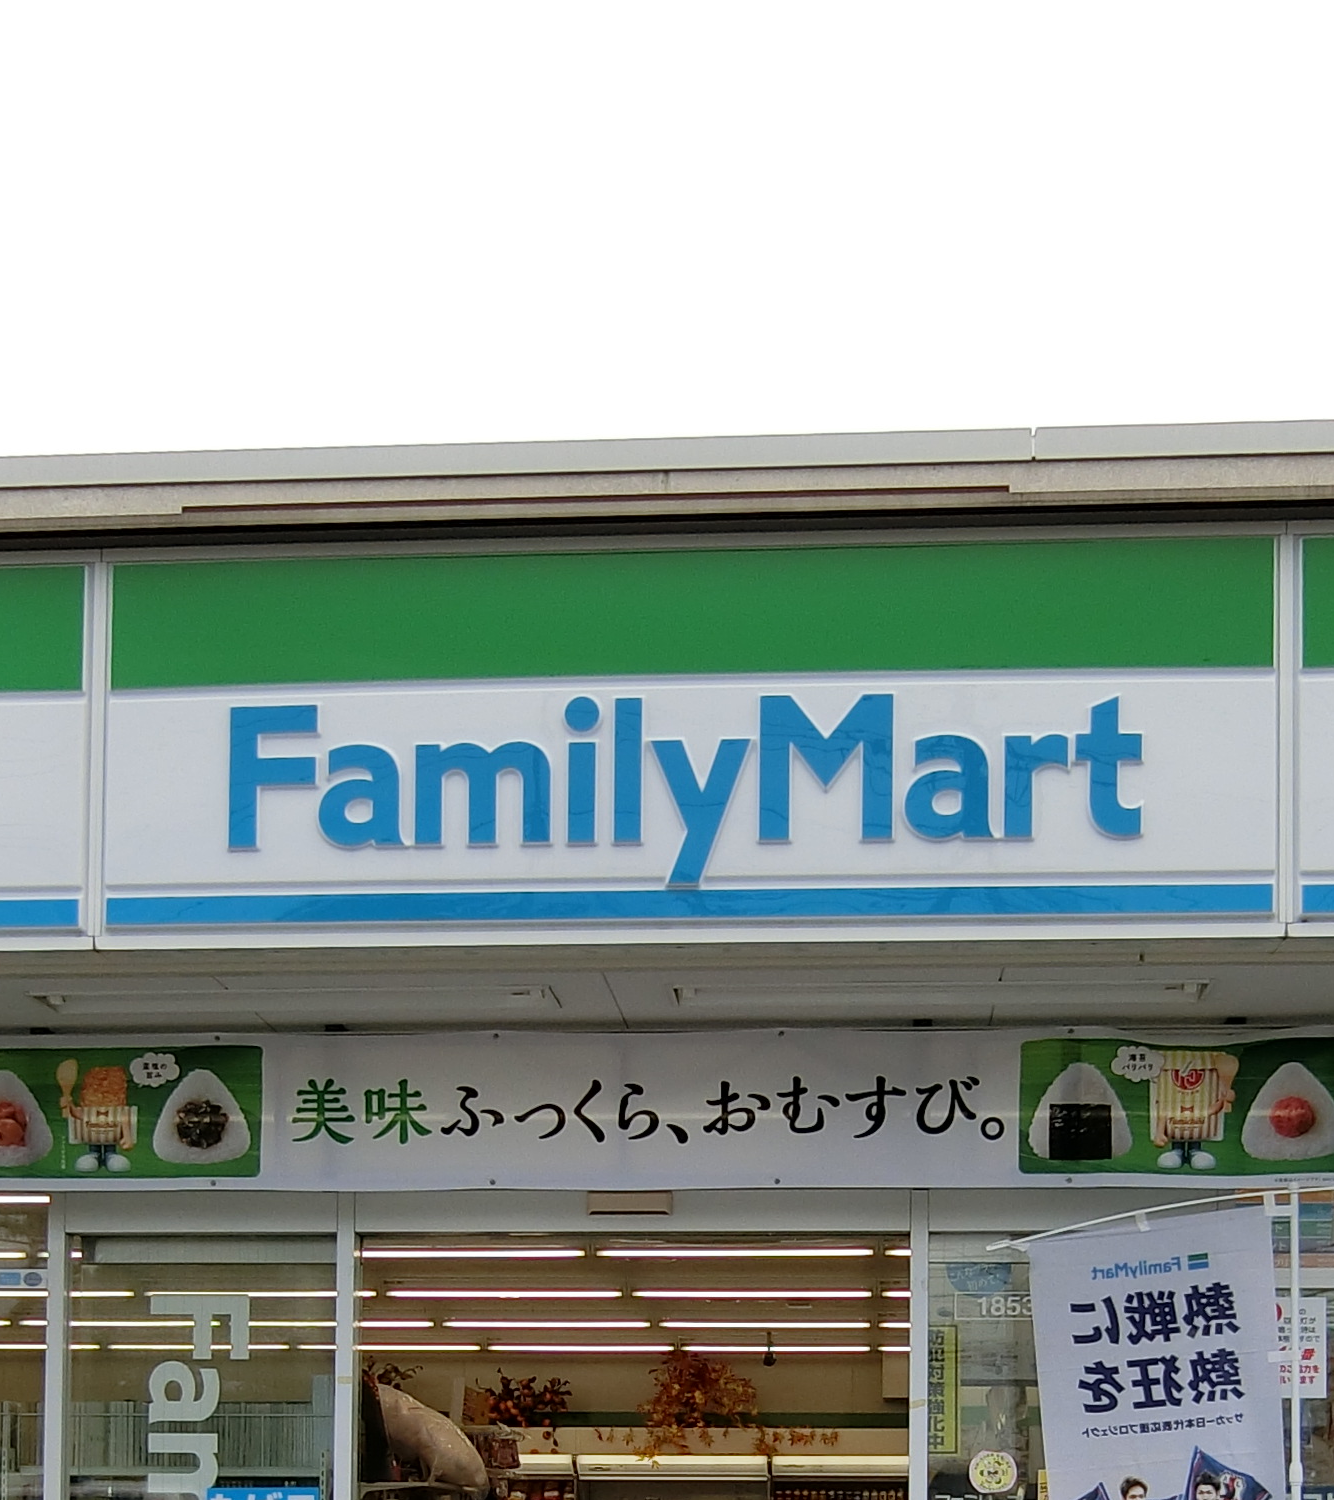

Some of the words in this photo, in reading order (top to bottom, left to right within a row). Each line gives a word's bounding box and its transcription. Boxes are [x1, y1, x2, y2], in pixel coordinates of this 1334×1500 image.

[227, 693, 1144, 888] FamilyMart
[291, 1075, 1007, 1146] 美味ふっくら、おむすび。
